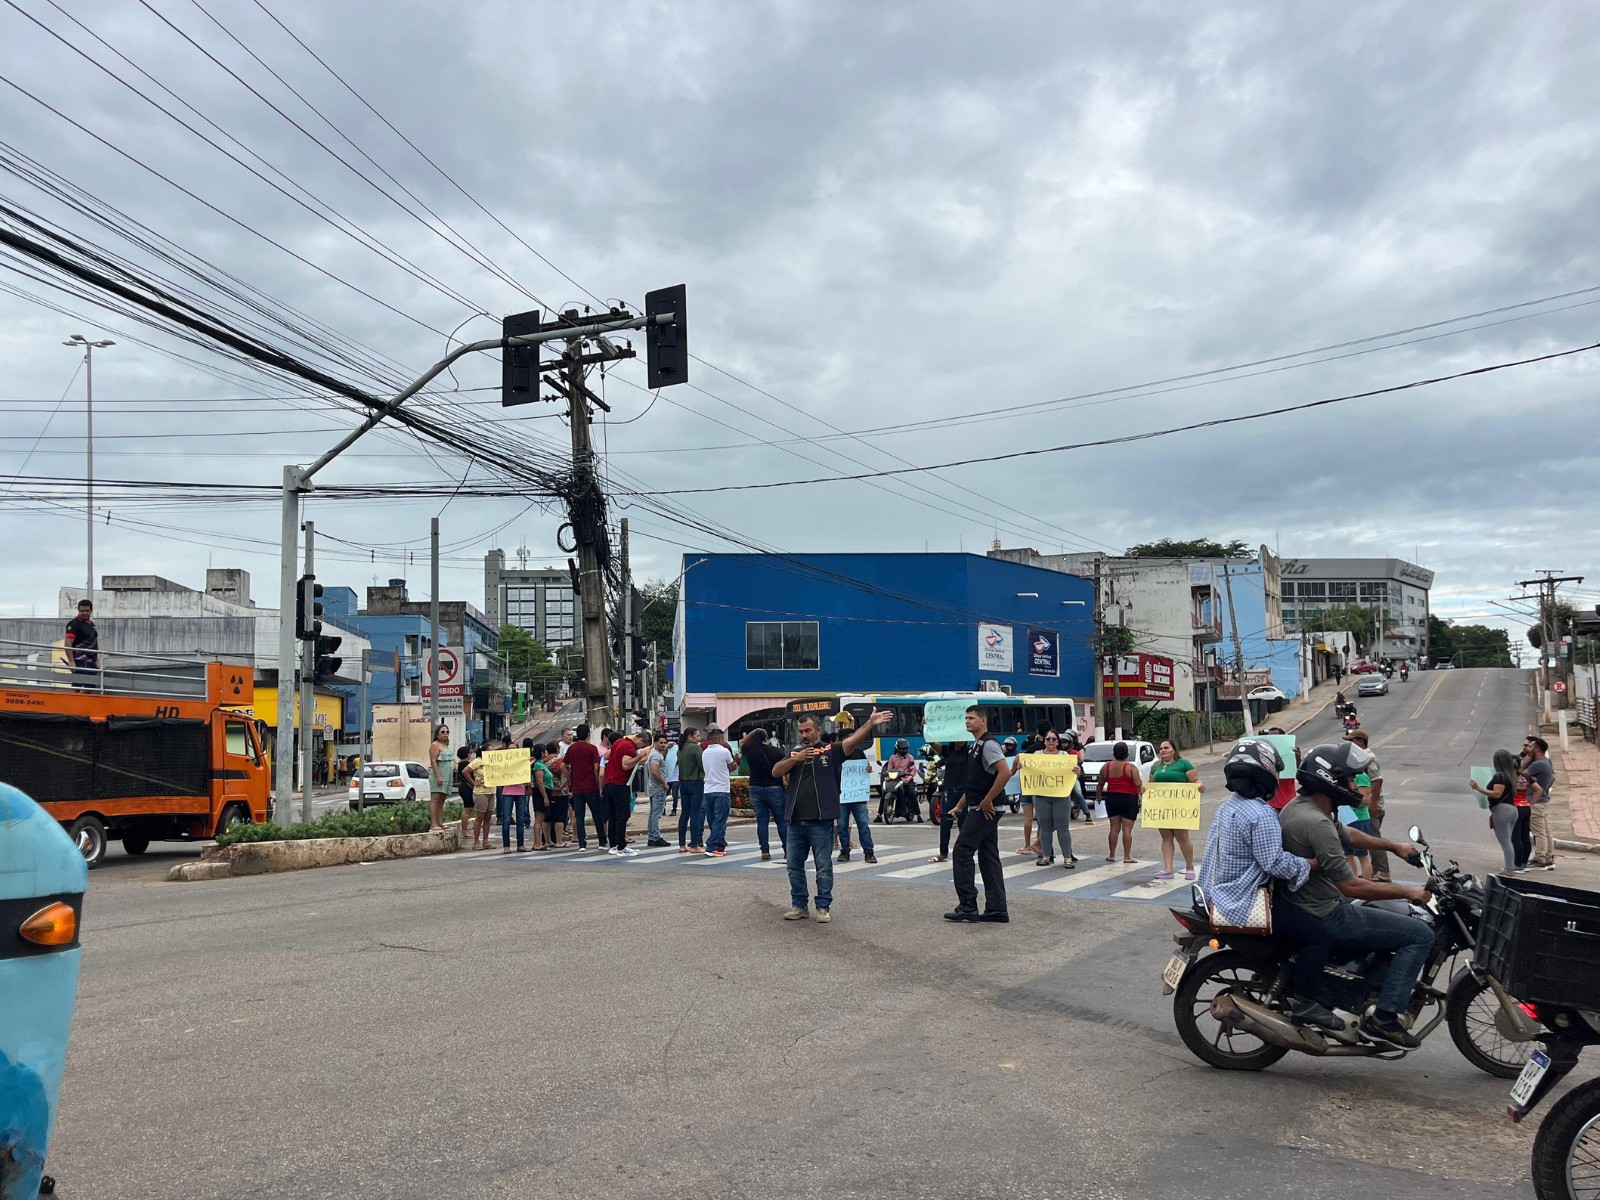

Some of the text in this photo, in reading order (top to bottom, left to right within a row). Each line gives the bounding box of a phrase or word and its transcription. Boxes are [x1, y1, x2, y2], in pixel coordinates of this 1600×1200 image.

[985, 652, 1005, 660] CENTRAL
[425, 687, 460, 695] PIBIDO
[154, 706, 180, 718] HD
[1023, 774, 1064, 789] NUNCA
[1316, 769, 1338, 784] GOW
[1144, 808, 1199, 820] MENTIROSO
